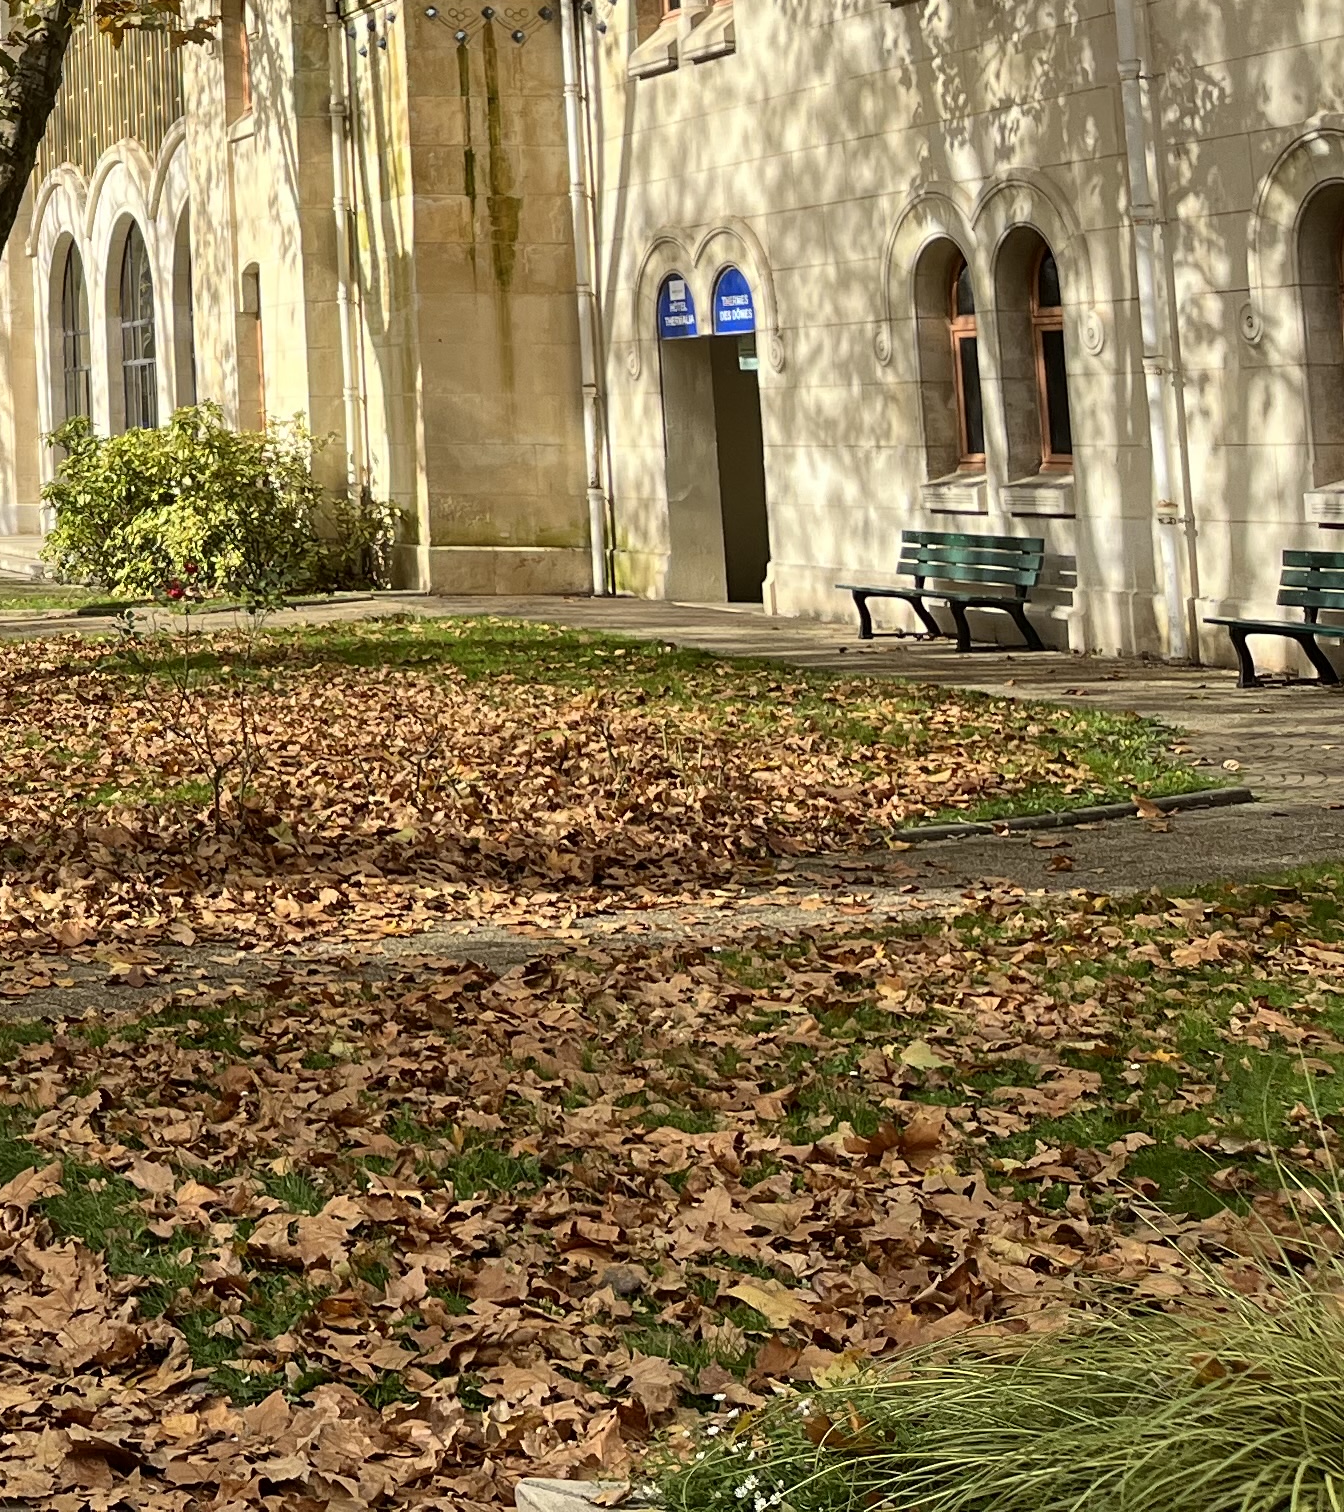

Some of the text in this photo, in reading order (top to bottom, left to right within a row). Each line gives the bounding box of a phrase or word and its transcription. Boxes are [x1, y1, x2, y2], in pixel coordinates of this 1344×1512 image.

[721, 294, 748, 306] THERMES
[719, 308, 752, 321] DES DÔMES
